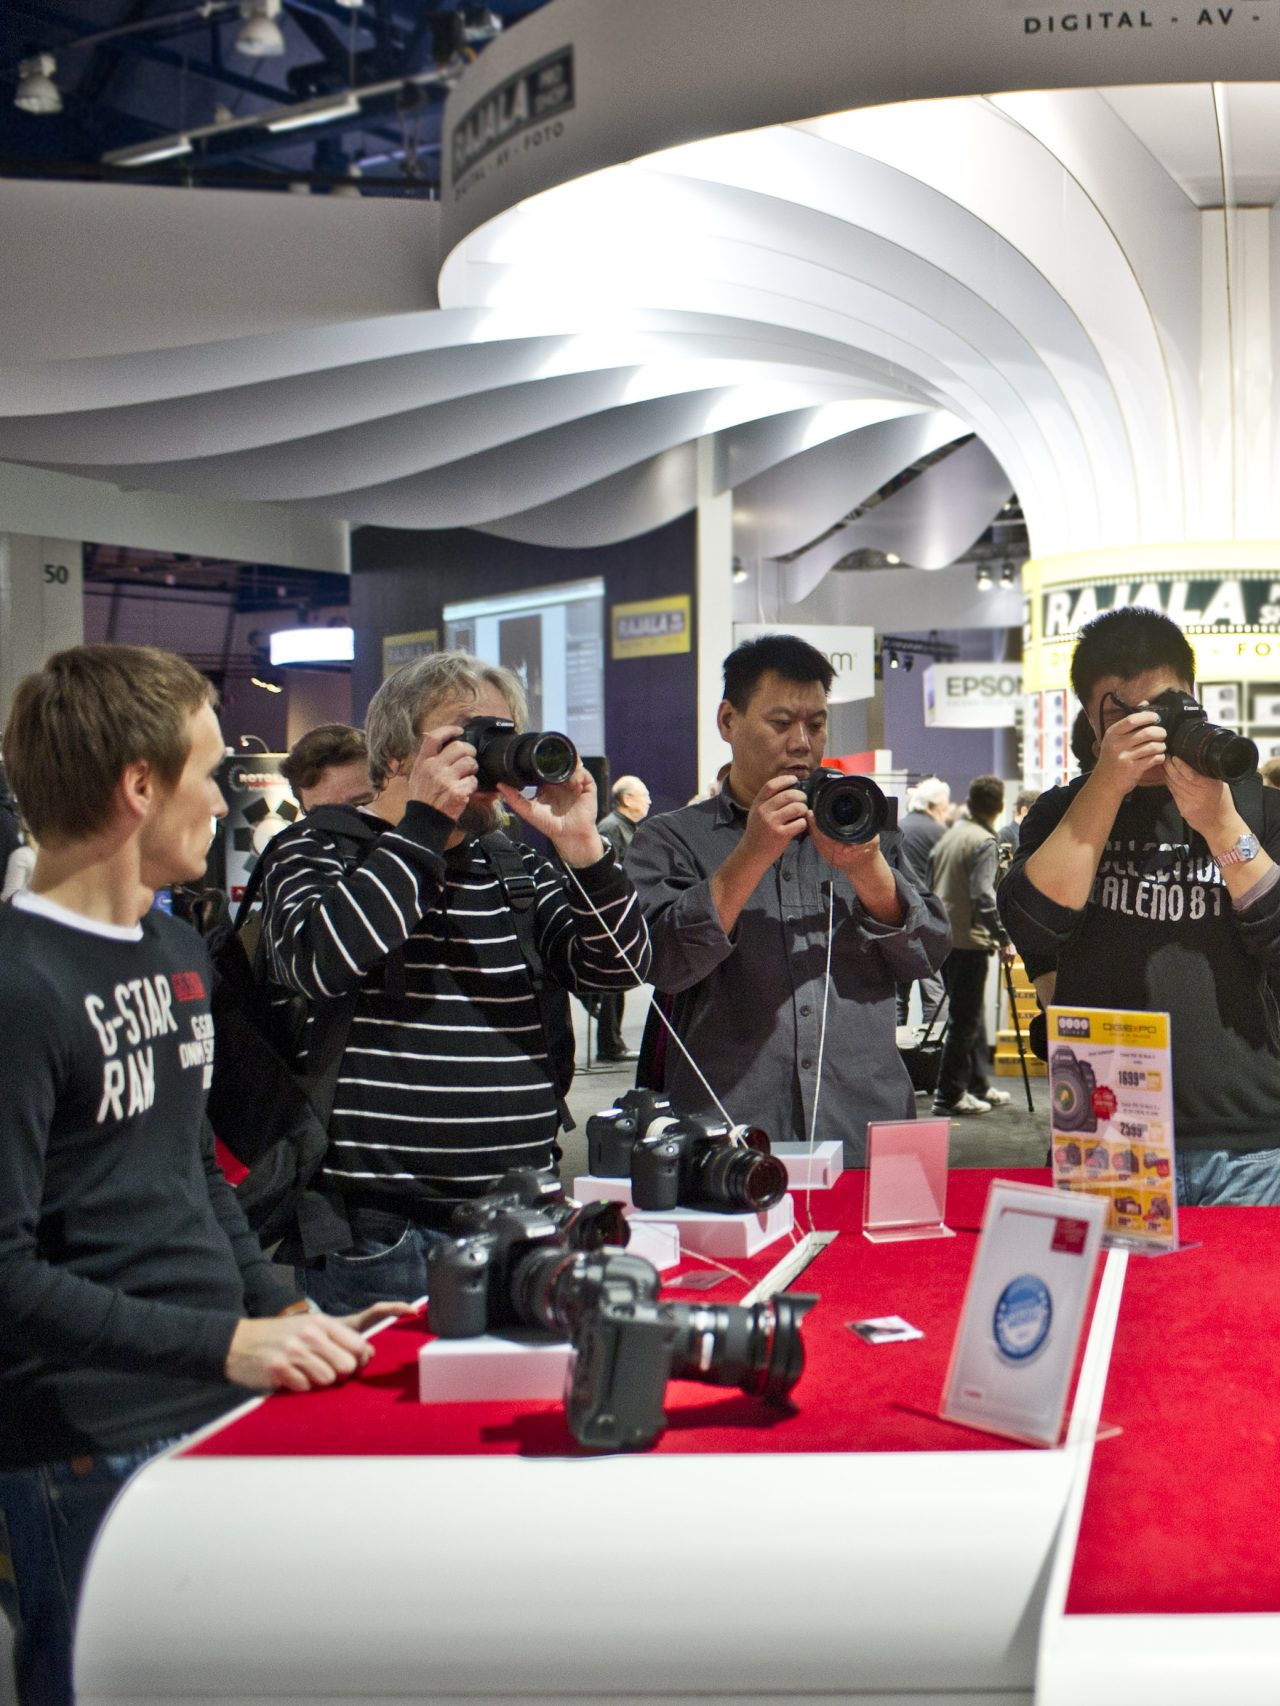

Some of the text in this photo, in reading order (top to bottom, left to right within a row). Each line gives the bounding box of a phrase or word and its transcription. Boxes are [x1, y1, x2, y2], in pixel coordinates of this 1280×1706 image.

[1024, 11, 1152, 34] DIGITAL
[1197, 9, 1234, 26] AV
[524, 121, 565, 151] FOTO
[44, 564, 68, 584] 50
[1089, 876, 1185, 922] ALENO
[85, 974, 178, 1056] G-STAR
[97, 1046, 155, 1123] RAW
